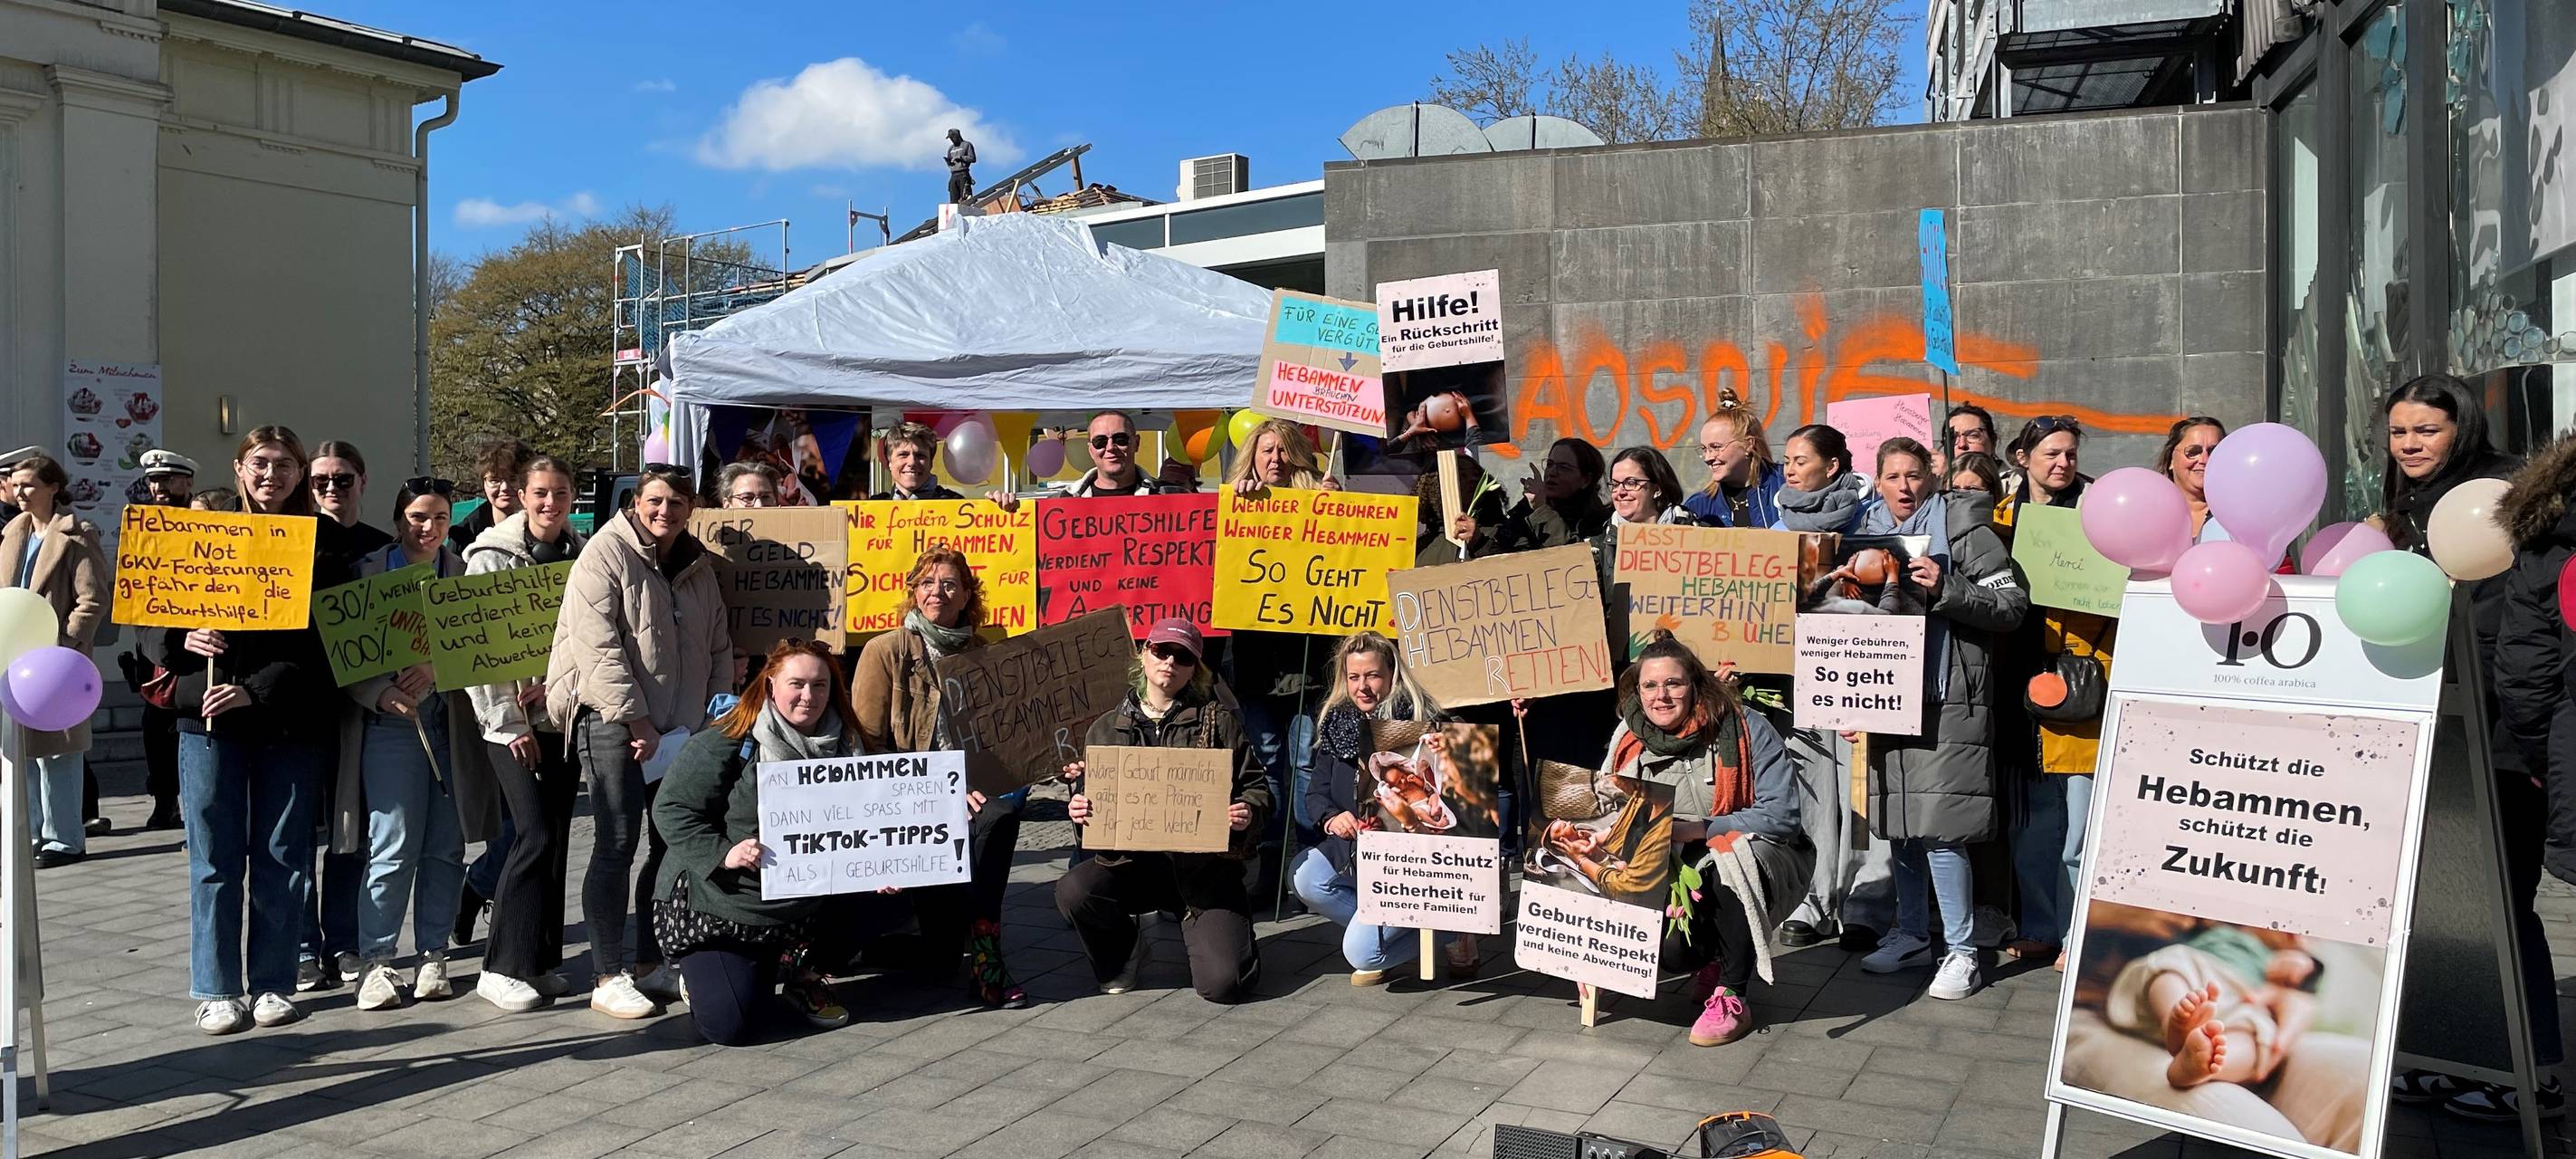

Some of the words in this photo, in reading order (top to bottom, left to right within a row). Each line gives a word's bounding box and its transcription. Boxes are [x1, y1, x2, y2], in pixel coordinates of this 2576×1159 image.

[1283, 306, 1315, 323] FÜR
[1391, 290, 1480, 323] Hilfe!
[1381, 335, 1397, 343] Ein
[1400, 319, 1499, 341] Rückschritt
[1392, 344, 1406, 353] für
[1409, 343, 1425, 351] die
[1427, 334, 1494, 350] Geburtshilfe!
[1277, 361, 1365, 393] HEBAMMEN
[1273, 389, 1386, 426] UNTERSTÜTZUN
[1232, 494, 1299, 514] WENIGER
[1312, 493, 1398, 520] GEBÜHREN
[127, 508, 253, 537] Hebammen
[270, 524, 286, 537] in
[687, 518, 755, 545] IGER
[1043, 507, 1216, 541] GEBURTSHILFE
[1224, 519, 1293, 541] WENIGER
[1302, 519, 1389, 548] HEBAMMEN
[194, 541, 238, 560] Not
[866, 535, 893, 551] FÜR
[1621, 525, 1694, 549] LASST
[1702, 529, 1749, 549] DIE
[747, 541, 816, 562] GELD
[1038, 552, 1112, 570] VERDIENT
[1123, 537, 1216, 567] RESPEKT
[1619, 550, 1798, 579] DIENSTBELEG-
[2049, 551, 2085, 570] Merci
[121, 553, 293, 582] GKV-Forderungen
[734, 569, 844, 592] HEBAMMEN
[997, 570, 1030, 587] FÜR
[264, 580, 291, 599] die
[428, 566, 567, 605] Geburtshilfe
[1069, 579, 1102, 593] UND
[1118, 576, 1159, 590] KEINE
[1681, 576, 1797, 603] HEBAMMEN
[146, 597, 269, 624] Geburtshilfe!
[320, 579, 375, 626] 30%
[434, 597, 525, 630] verdient
[1065, 594, 1213, 626] ARTUNG
[1629, 594, 1766, 623] WEITERHIN
[751, 607, 772, 627] ES
[778, 605, 842, 630] NICHT!
[330, 623, 392, 672] 100%
[440, 627, 489, 651] und
[1405, 616, 1558, 668] HEBAMMEN
[1807, 636, 1848, 647] Weniger
[1852, 637, 1909, 649] Gebühren,
[1485, 637, 1609, 696] RETTEN!
[1800, 649, 1841, 659] weniger
[1844, 649, 1907, 660] Hebammen
[945, 626, 1125, 718] DIENSTBELEG-
[1815, 666, 1839, 682] So
[1846, 668, 1894, 687] geht
[2213, 674, 2241, 684] 100%
[2244, 675, 2275, 686] coffea
[2278, 679, 2316, 689] arabica
[1812, 694, 1834, 707] es
[1842, 693, 1903, 711] nicht!
[957, 678, 1091, 754] HEBAMMEN
[1123, 753, 1162, 782] Geburt
[2189, 748, 2280, 773] Schützt
[2287, 759, 2325, 777] die
[769, 772, 788, 786] AN
[1125, 790, 1140, 804] es
[1165, 784, 1203, 809] Prämie
[2137, 774, 2370, 831] Hebammen,
[769, 809, 812, 828] DANN
[863, 801, 902, 818] SPASS
[1126, 810, 1154, 841] jede
[1164, 809, 1202, 836] Wehe!
[2179, 818, 2267, 841] schützt
[2275, 828, 2314, 848] die
[1361, 850, 1381, 861] Wir
[1384, 852, 1427, 865] fordern
[1431, 851, 1493, 869] Schutz
[2161, 845, 2327, 895] Zukunft!
[786, 863, 817, 884] ALS
[1383, 866, 1399, 876] für
[1403, 867, 1473, 883] Hebammen,
[1371, 881, 1464, 900] Sicherheit
[1468, 892, 1486, 902] für
[1379, 900, 1420, 910] unsere
[1423, 902, 1477, 915] Familien!
[1528, 902, 1648, 943] Geburtshilfe
[1518, 922, 1583, 947] verdient
[1588, 937, 1656, 964] Respekt
[1523, 939, 1544, 951] und
[1548, 943, 1579, 960] keine
[1582, 953, 1652, 978] Abwertung!
